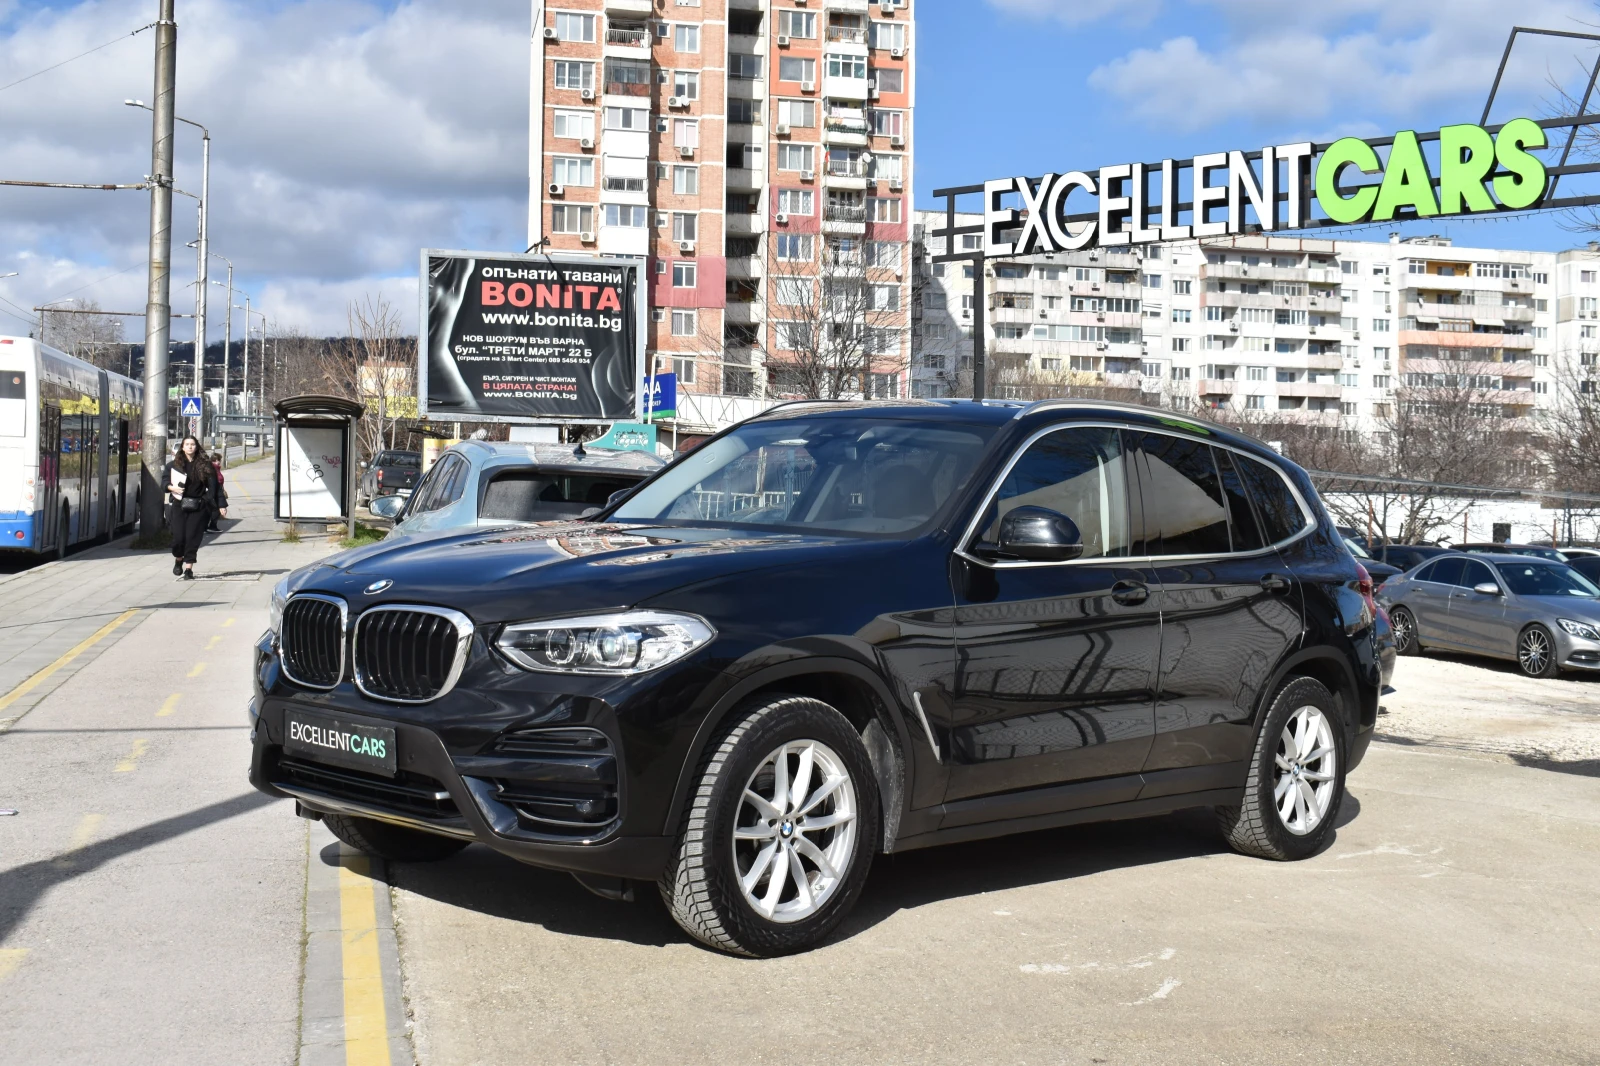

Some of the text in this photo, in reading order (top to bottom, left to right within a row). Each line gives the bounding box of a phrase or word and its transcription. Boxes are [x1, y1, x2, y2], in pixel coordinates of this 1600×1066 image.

[481, 266, 622, 284] опънати тавани
[481, 312, 622, 332] www.bonita.bg
[462, 334, 585, 346] НОВ ШОУРУМ ВЪВ ВАРНА
[454, 344, 479, 356] бул.
[568, 348, 581, 357] 22
[584, 348, 593, 357] Б
[482, 382, 577, 391] В ЦЯЛАТА СТРАНА!
[483, 391, 578, 401] www.BONITA.bg
